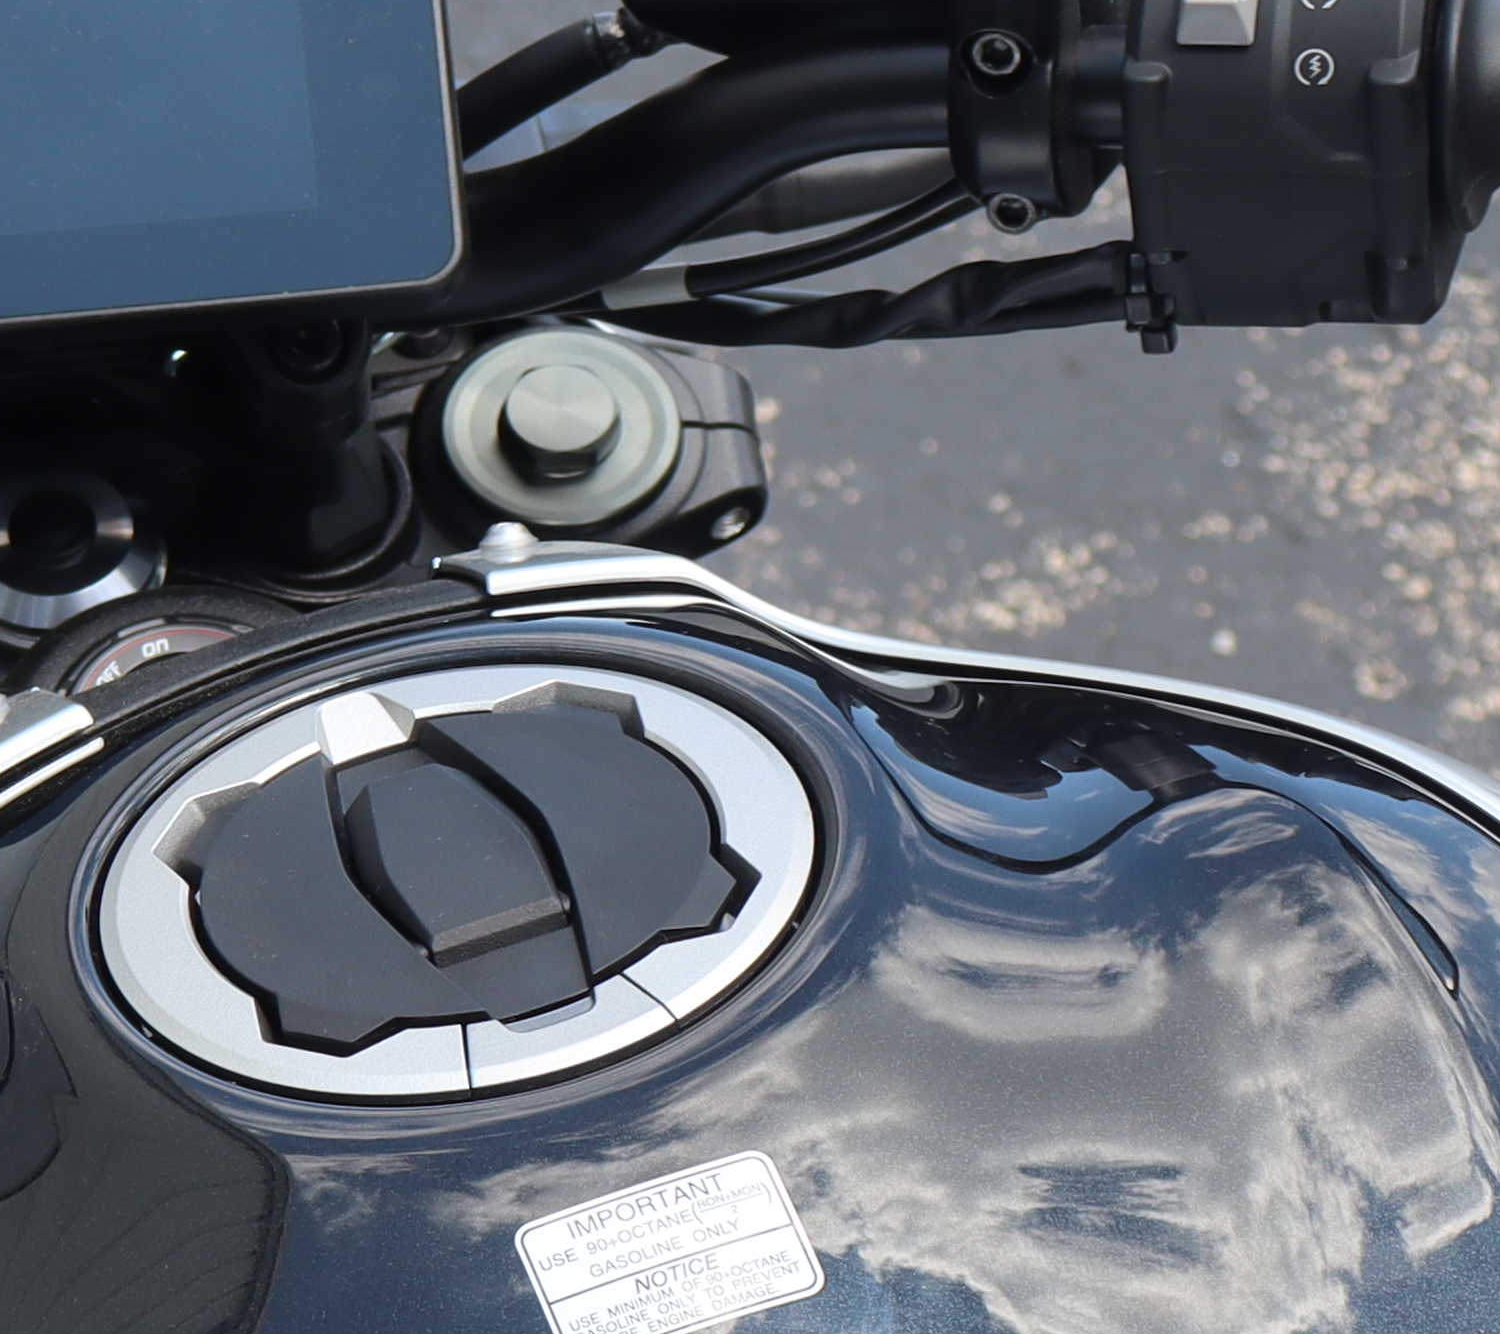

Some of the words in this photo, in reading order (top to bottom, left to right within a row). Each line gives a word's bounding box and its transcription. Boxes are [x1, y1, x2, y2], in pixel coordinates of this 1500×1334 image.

[566, 1172, 723, 1240] IMPORTANT
[538, 1247, 578, 1272] USE
[589, 1236, 684, 1278] GASOLINE
[692, 1217, 740, 1244] ONLY
[635, 1252, 719, 1294] NOTICE
[568, 1312, 601, 1333] USE
[607, 1287, 675, 1318] MINIMUM
[681, 1277, 702, 1293] OF
[705, 1250, 792, 1285] 90+OCTANE
[648, 1305, 705, 1334] ENGINE
[712, 1283, 781, 1312] DAMAGE.
[659, 1293, 697, 1315] ONLY
[703, 1284, 725, 1299] TO
[732, 1260, 802, 1291] PREVENT
